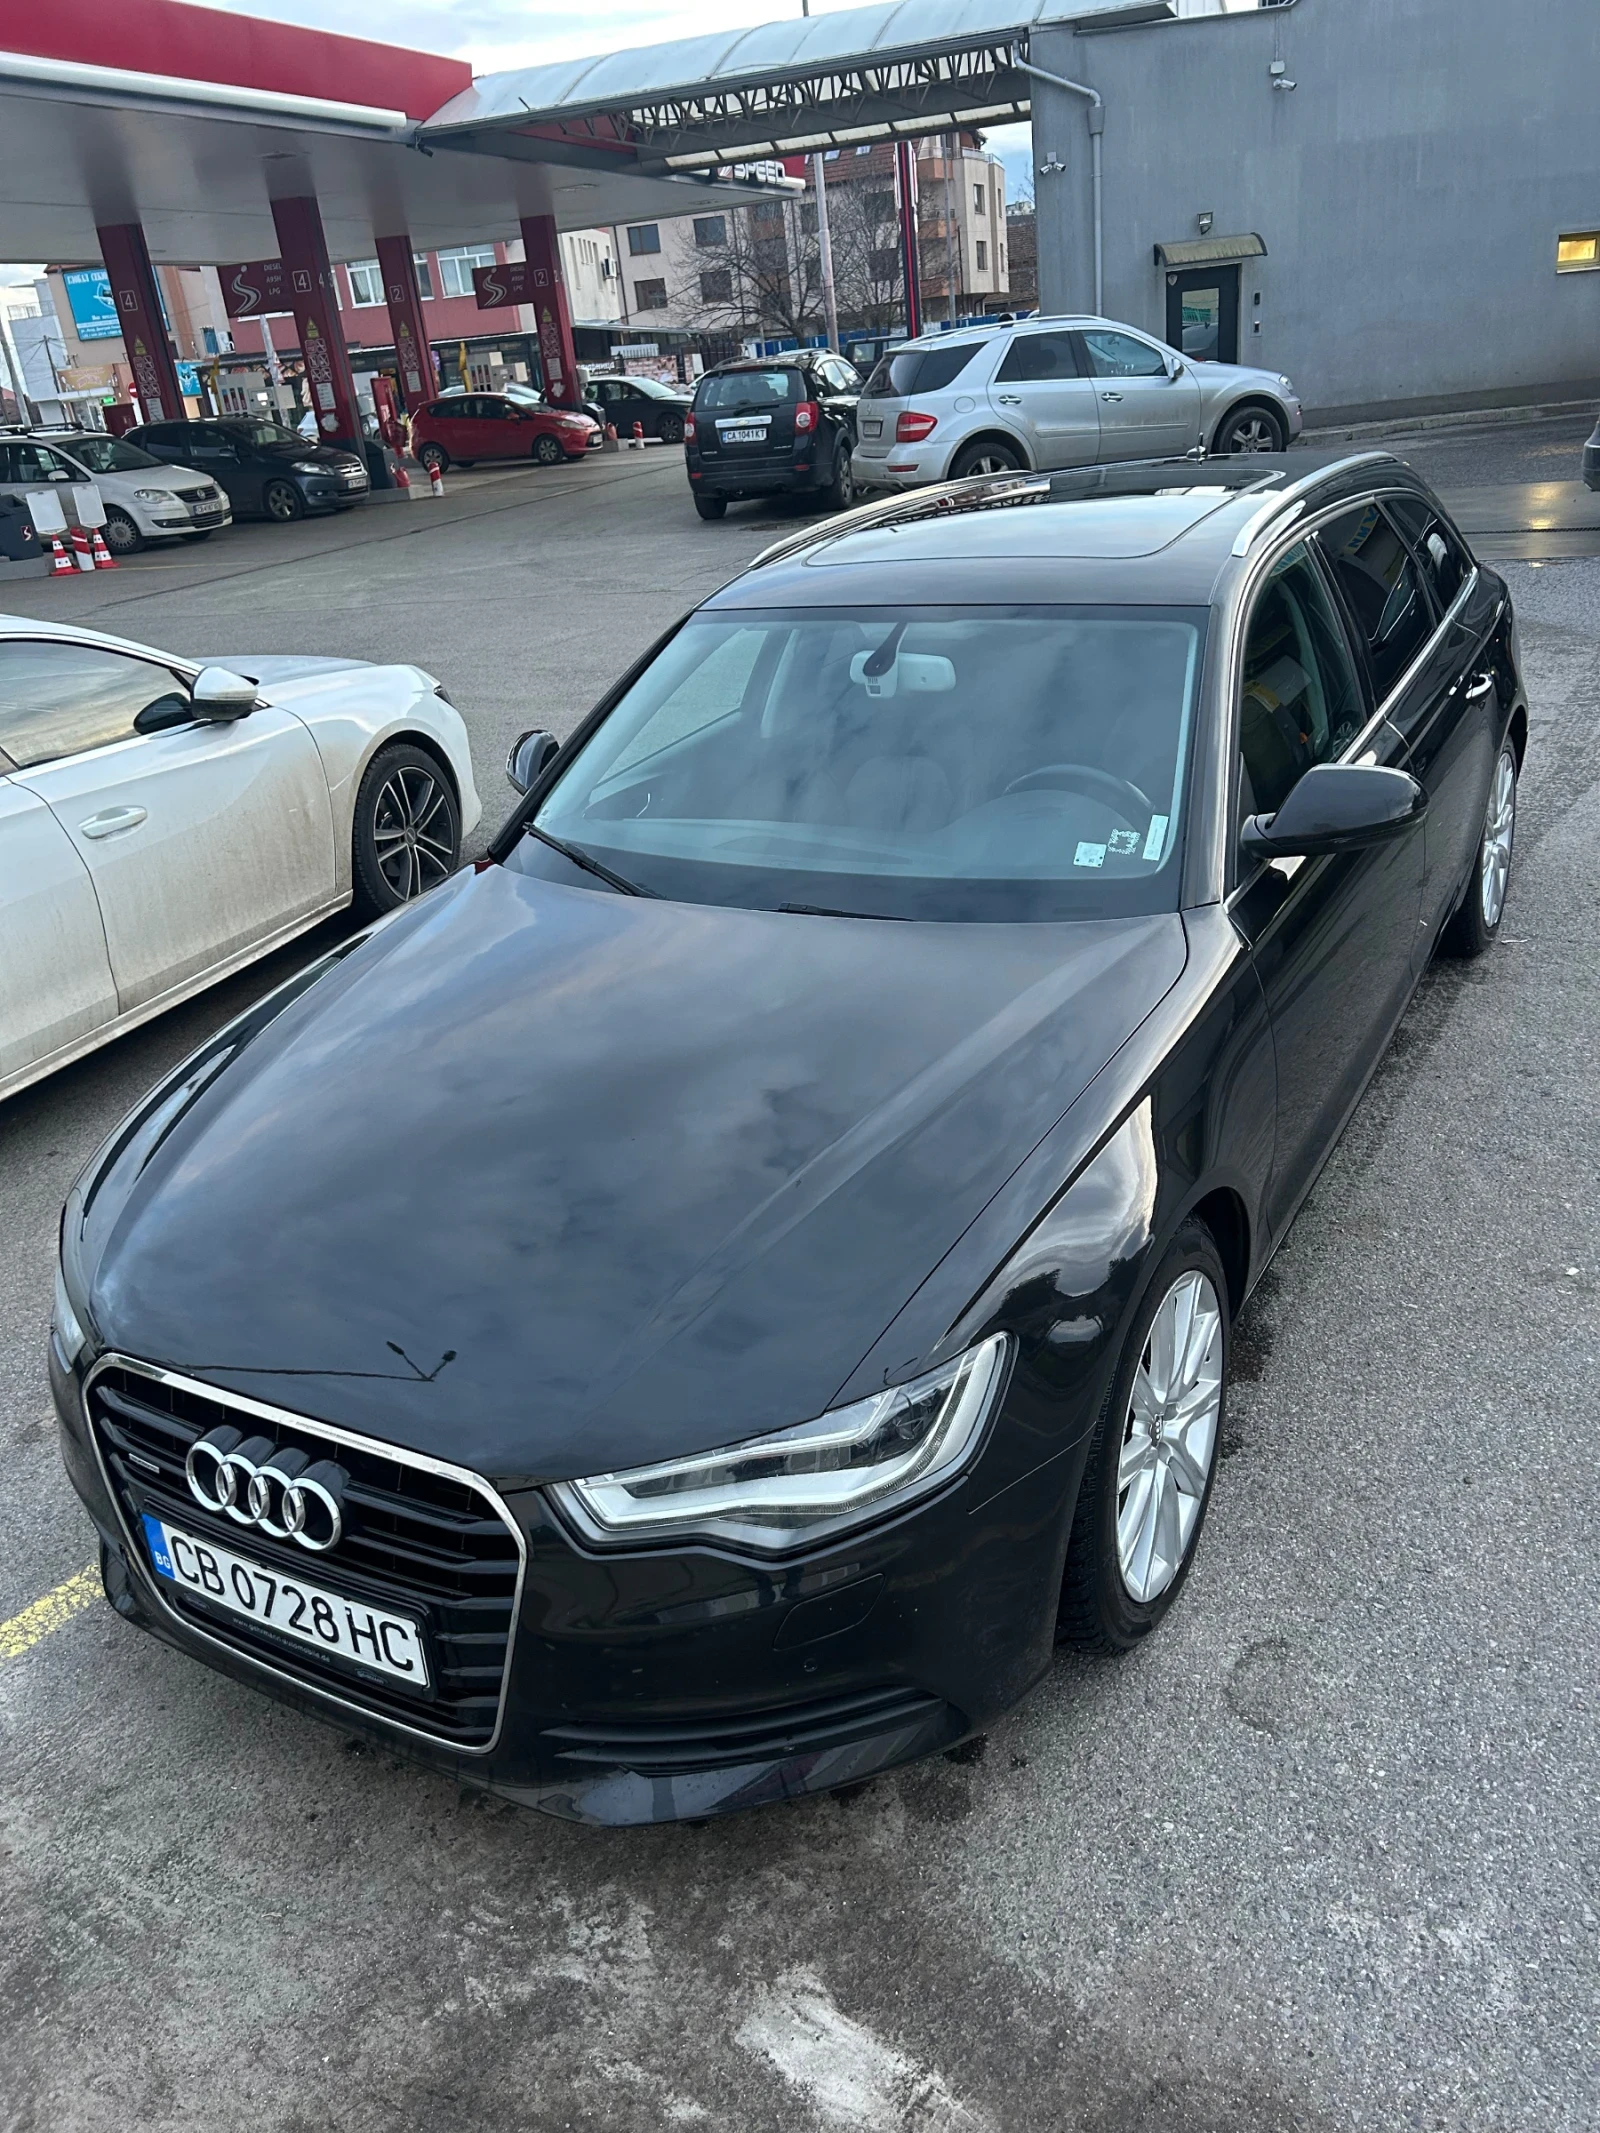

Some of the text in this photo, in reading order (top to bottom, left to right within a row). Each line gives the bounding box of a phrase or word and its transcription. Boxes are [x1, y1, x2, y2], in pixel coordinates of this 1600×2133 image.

[264, 262, 282, 271] DIESEL
[298, 273, 307, 289] 4
[537, 271, 546, 284] 2
[269, 287, 281, 296] LPG
[393, 288, 402, 301] 2
[125, 294, 134, 309] 4
[154, 1550, 171, 1570] BG
[171, 1535, 414, 1672] CB 0728 HC
